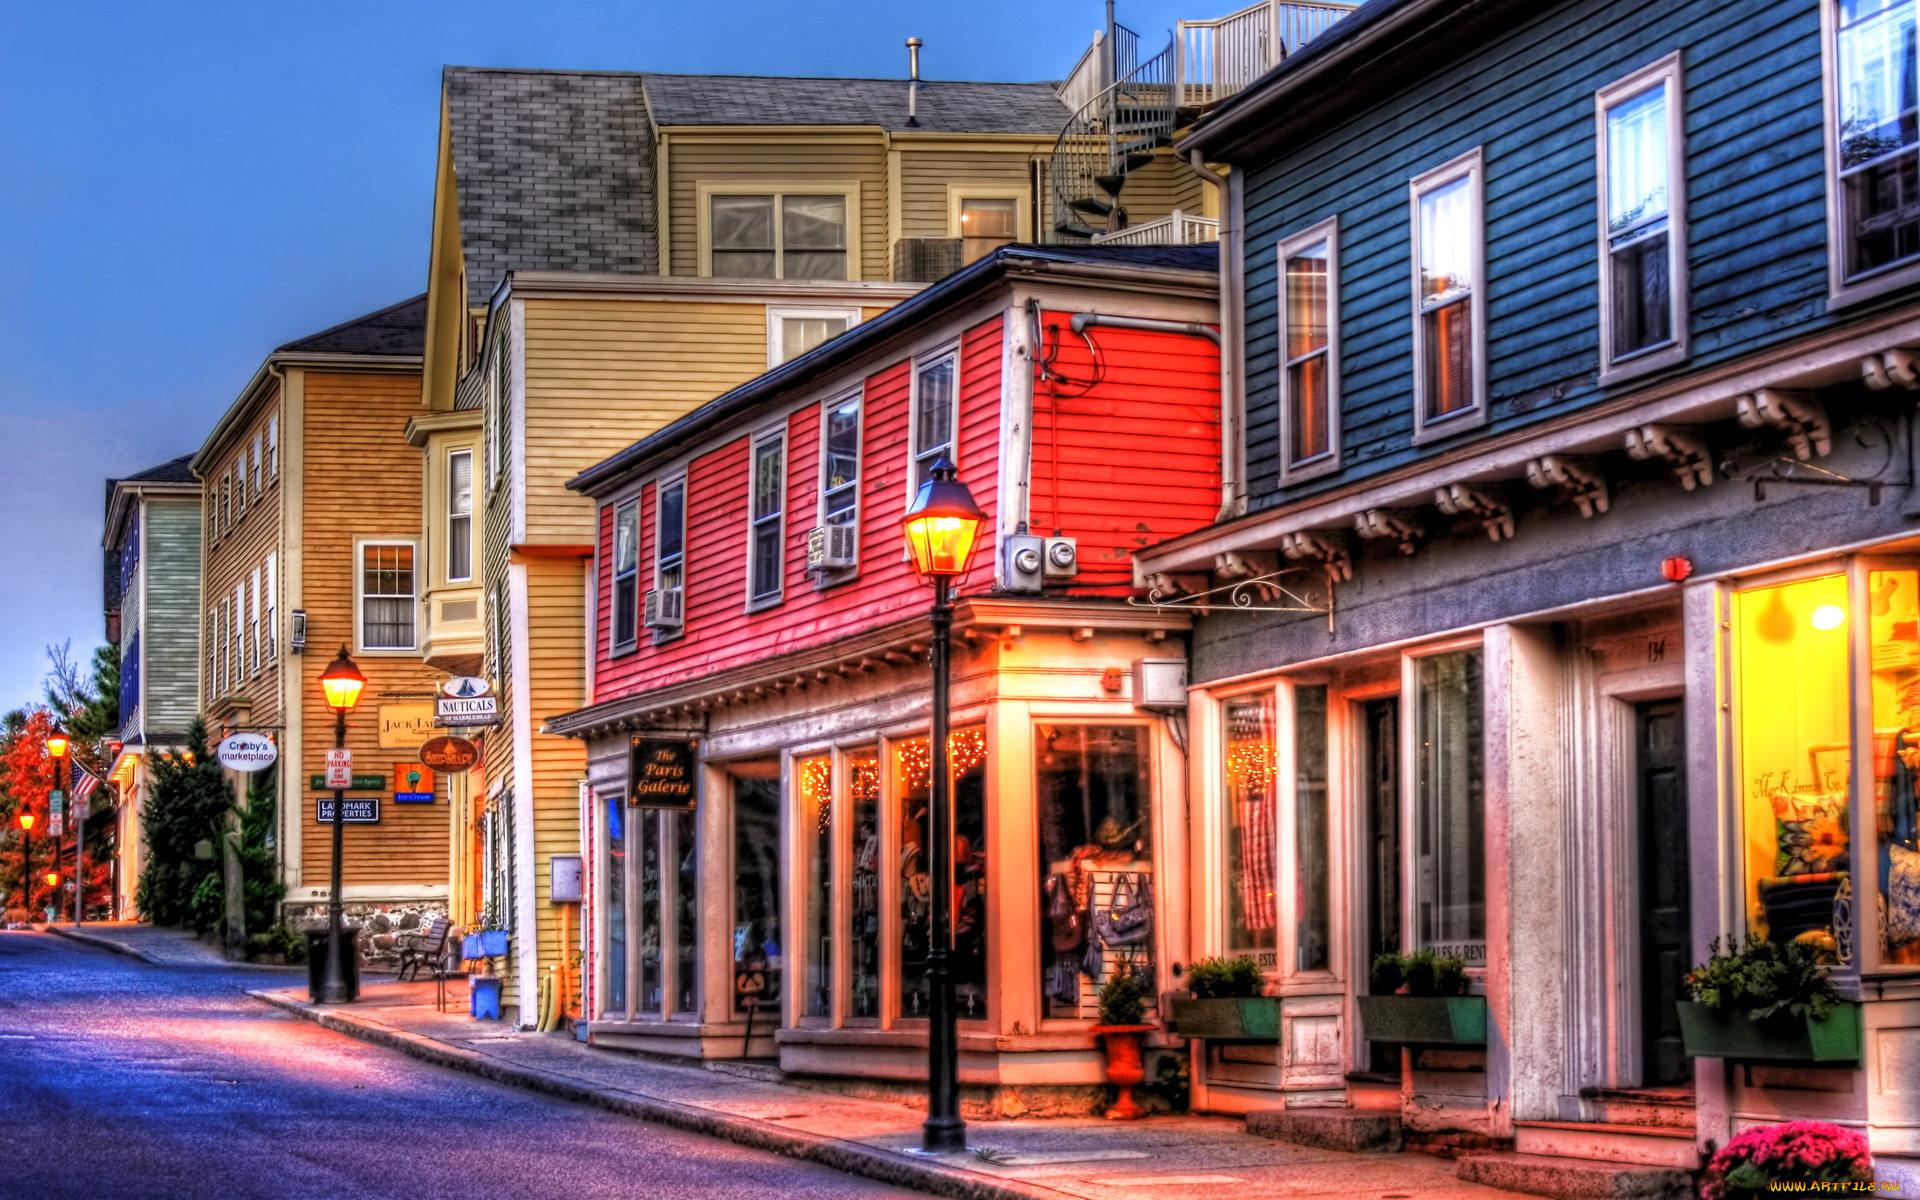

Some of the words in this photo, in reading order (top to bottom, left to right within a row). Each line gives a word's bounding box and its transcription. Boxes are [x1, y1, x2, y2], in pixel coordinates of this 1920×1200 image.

[1648, 639, 1665, 663] 134
[442, 700, 493, 713] NAUTICALS
[229, 741, 268, 752] Crosby's
[221, 752, 274, 762] marketplace
[334, 751, 344, 760] NO
[656, 751, 676, 760] The
[327, 760, 351, 768] PARKING
[645, 763, 684, 777] Paris
[638, 779, 690, 795] Galerie
